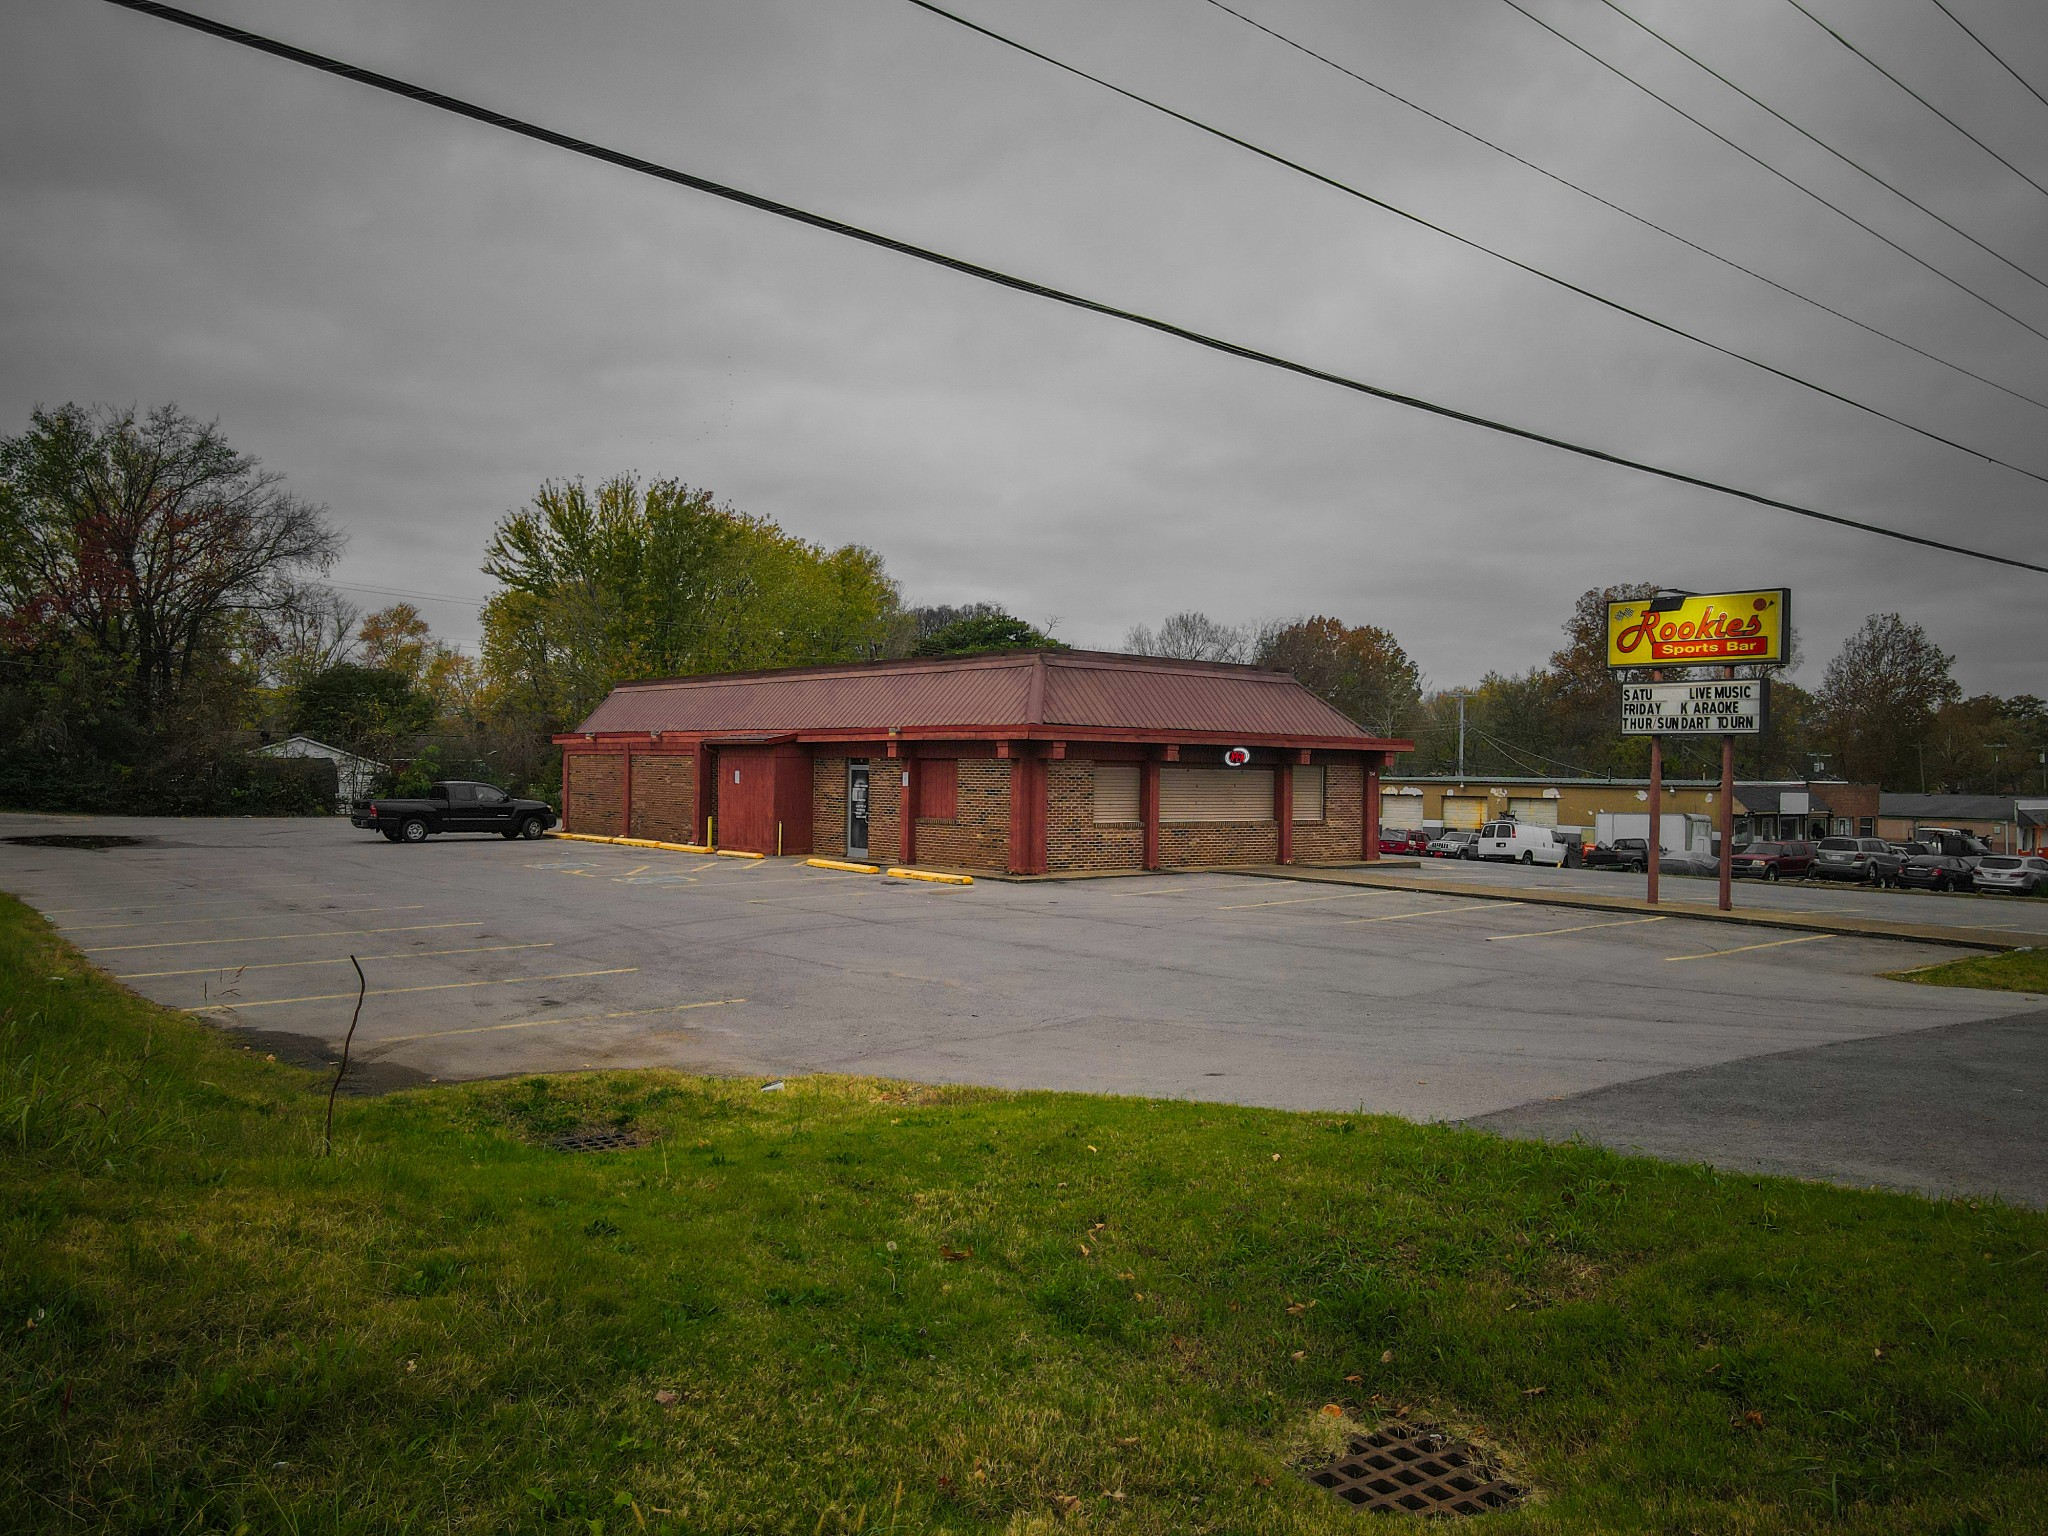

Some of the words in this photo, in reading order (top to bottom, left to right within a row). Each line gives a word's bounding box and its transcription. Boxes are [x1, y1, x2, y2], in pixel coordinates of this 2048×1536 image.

[1617, 606, 1762, 653] Rookies
[1662, 644, 1719, 656] Sports
[1726, 641, 1757, 652] Bar
[1623, 688, 1653, 701] SATU
[1689, 687, 1712, 700] LIVE
[1714, 685, 1752, 699] MUSIC
[1623, 703, 1662, 715] FRIDAY
[1681, 716, 1711, 730] DART
